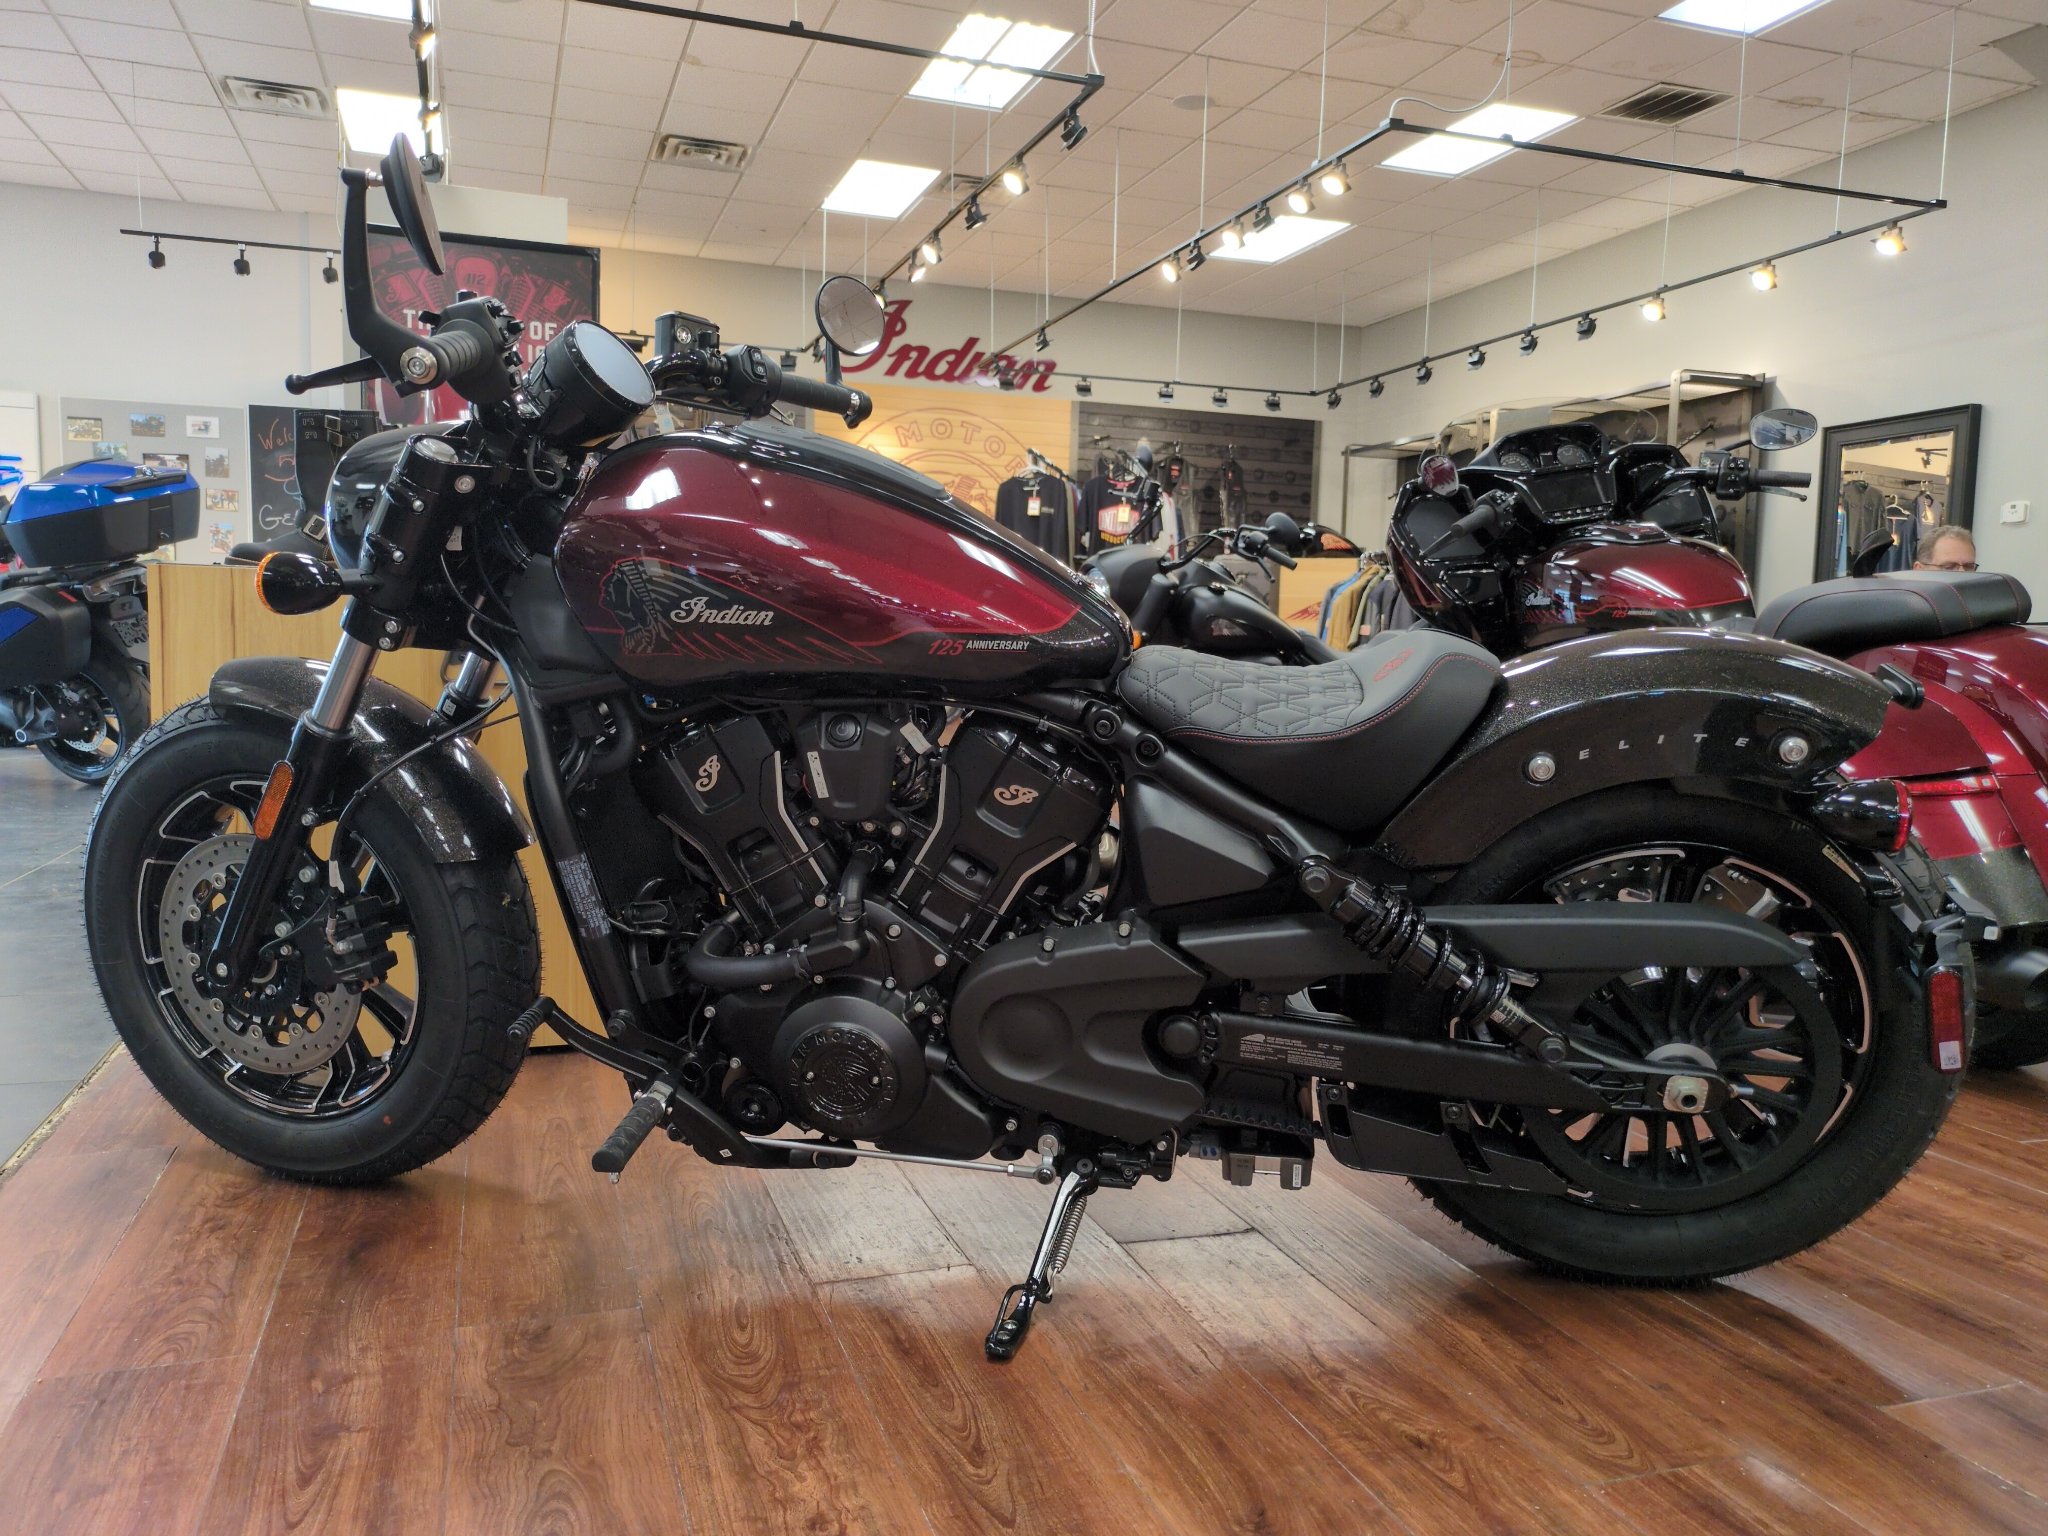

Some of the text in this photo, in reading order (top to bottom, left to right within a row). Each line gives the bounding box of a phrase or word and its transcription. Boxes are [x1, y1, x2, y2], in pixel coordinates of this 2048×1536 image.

[529, 321, 557, 343] OF
[670, 596, 774, 625] Indian
[928, 639, 1030, 656] 125 ANNIVERSARY
[1579, 733, 1750, 760] ELITE
